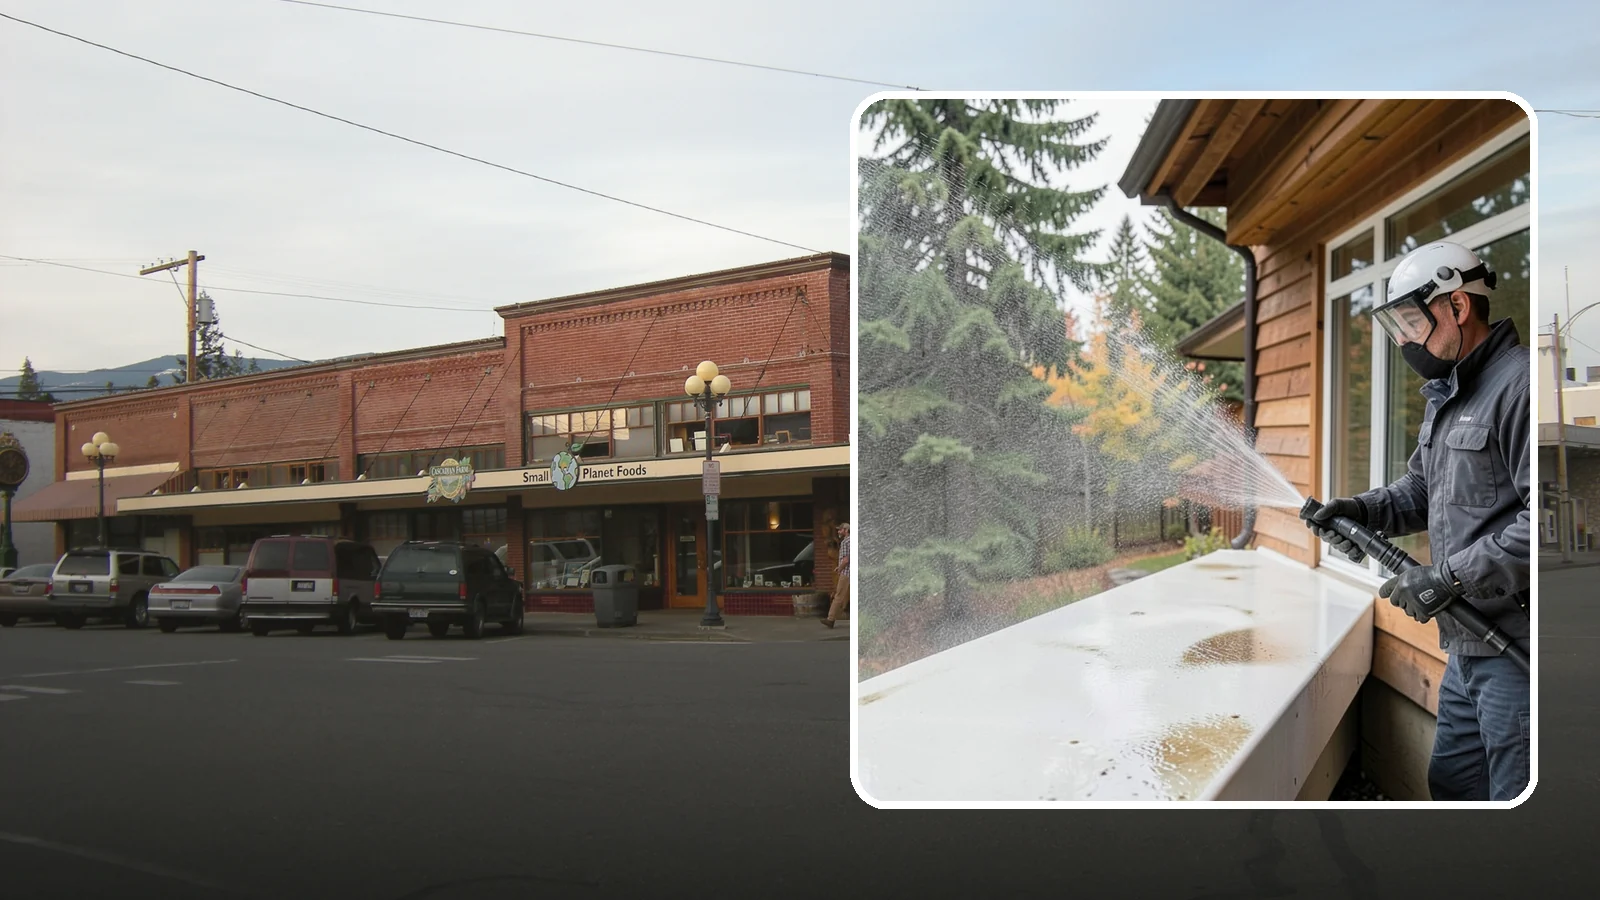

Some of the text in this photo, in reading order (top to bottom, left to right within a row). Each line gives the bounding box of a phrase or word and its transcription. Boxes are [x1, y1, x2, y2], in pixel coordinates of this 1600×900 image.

[523, 464, 647, 483] Small Planet Foods
